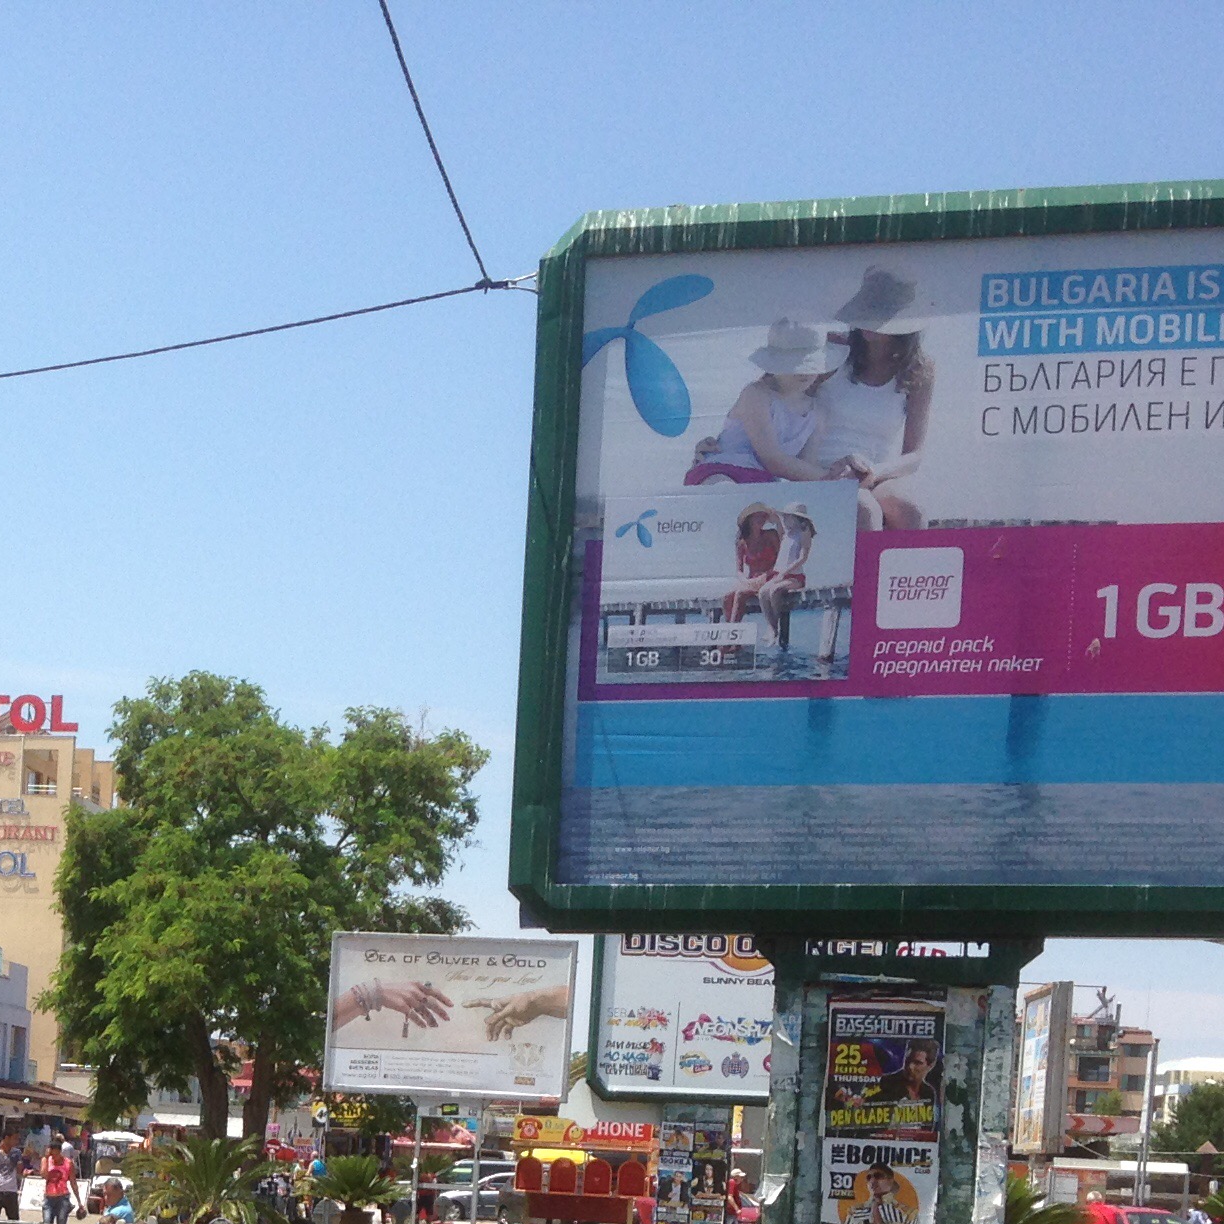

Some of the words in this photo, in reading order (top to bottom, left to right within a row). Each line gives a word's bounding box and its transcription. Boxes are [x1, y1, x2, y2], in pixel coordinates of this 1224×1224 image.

[987, 271, 1177, 308] BULGARIA
[1187, 269, 1221, 301] IS
[984, 317, 1084, 350] WITH
[1096, 313, 1224, 345] MOBIL
[983, 357, 1166, 393] БЪЛГАРИЯ
[1012, 402, 1191, 434] МОБИЛЕН
[657, 519, 704, 534] telenor
[1136, 582, 1224, 639] GB
[699, 649, 722, 666] 30
[403, 955, 422, 964] OF
[486, 957, 497, 967] &
[702, 976, 745, 985] SUNNY
[835, 1018, 936, 1035] BASSHUNTER
[835, 1044, 862, 1065] 25
[833, 1074, 882, 1083] THURSDAY
[830, 1109, 852, 1127] DEN
[854, 1107, 890, 1125] GLADE
[831, 1143, 845, 1165] THE
[846, 1144, 932, 1167] BOUNCE
[832, 1175, 853, 1189] 30
